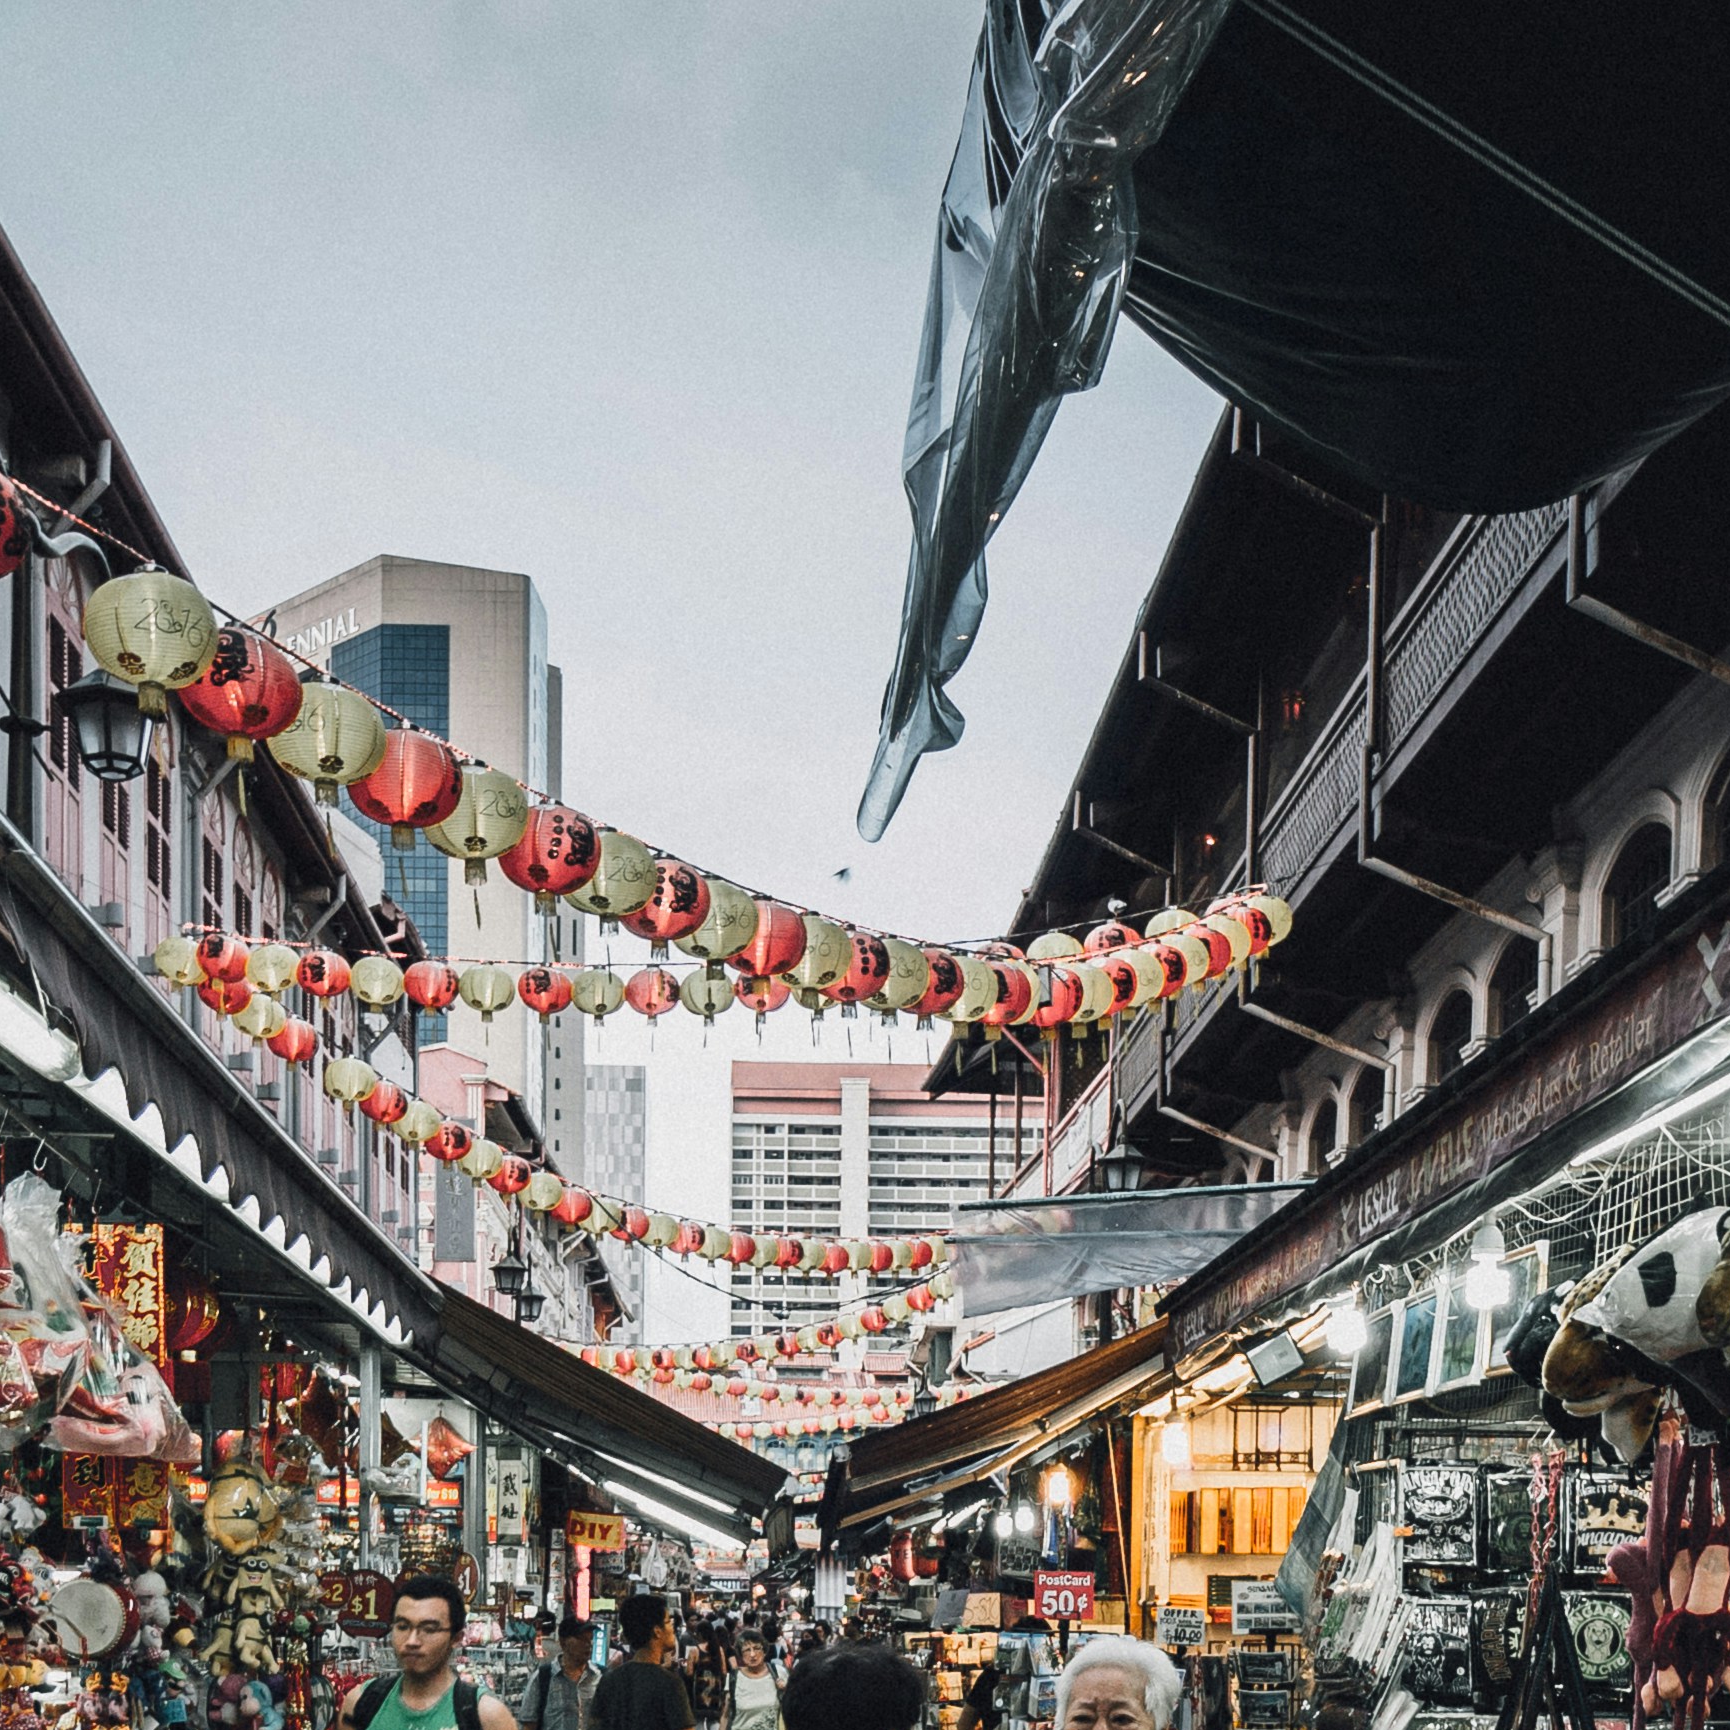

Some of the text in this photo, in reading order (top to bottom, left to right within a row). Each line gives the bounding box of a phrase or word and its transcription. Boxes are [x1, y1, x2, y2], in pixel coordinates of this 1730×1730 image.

[1589, 1013, 1654, 1083] Retailer
[569, 1519, 614, 1540] DIY
[1037, 1573, 1091, 1588] PostCard
[351, 1588, 380, 1620] $1
[1163, 1607, 1199, 1619] OFFER
